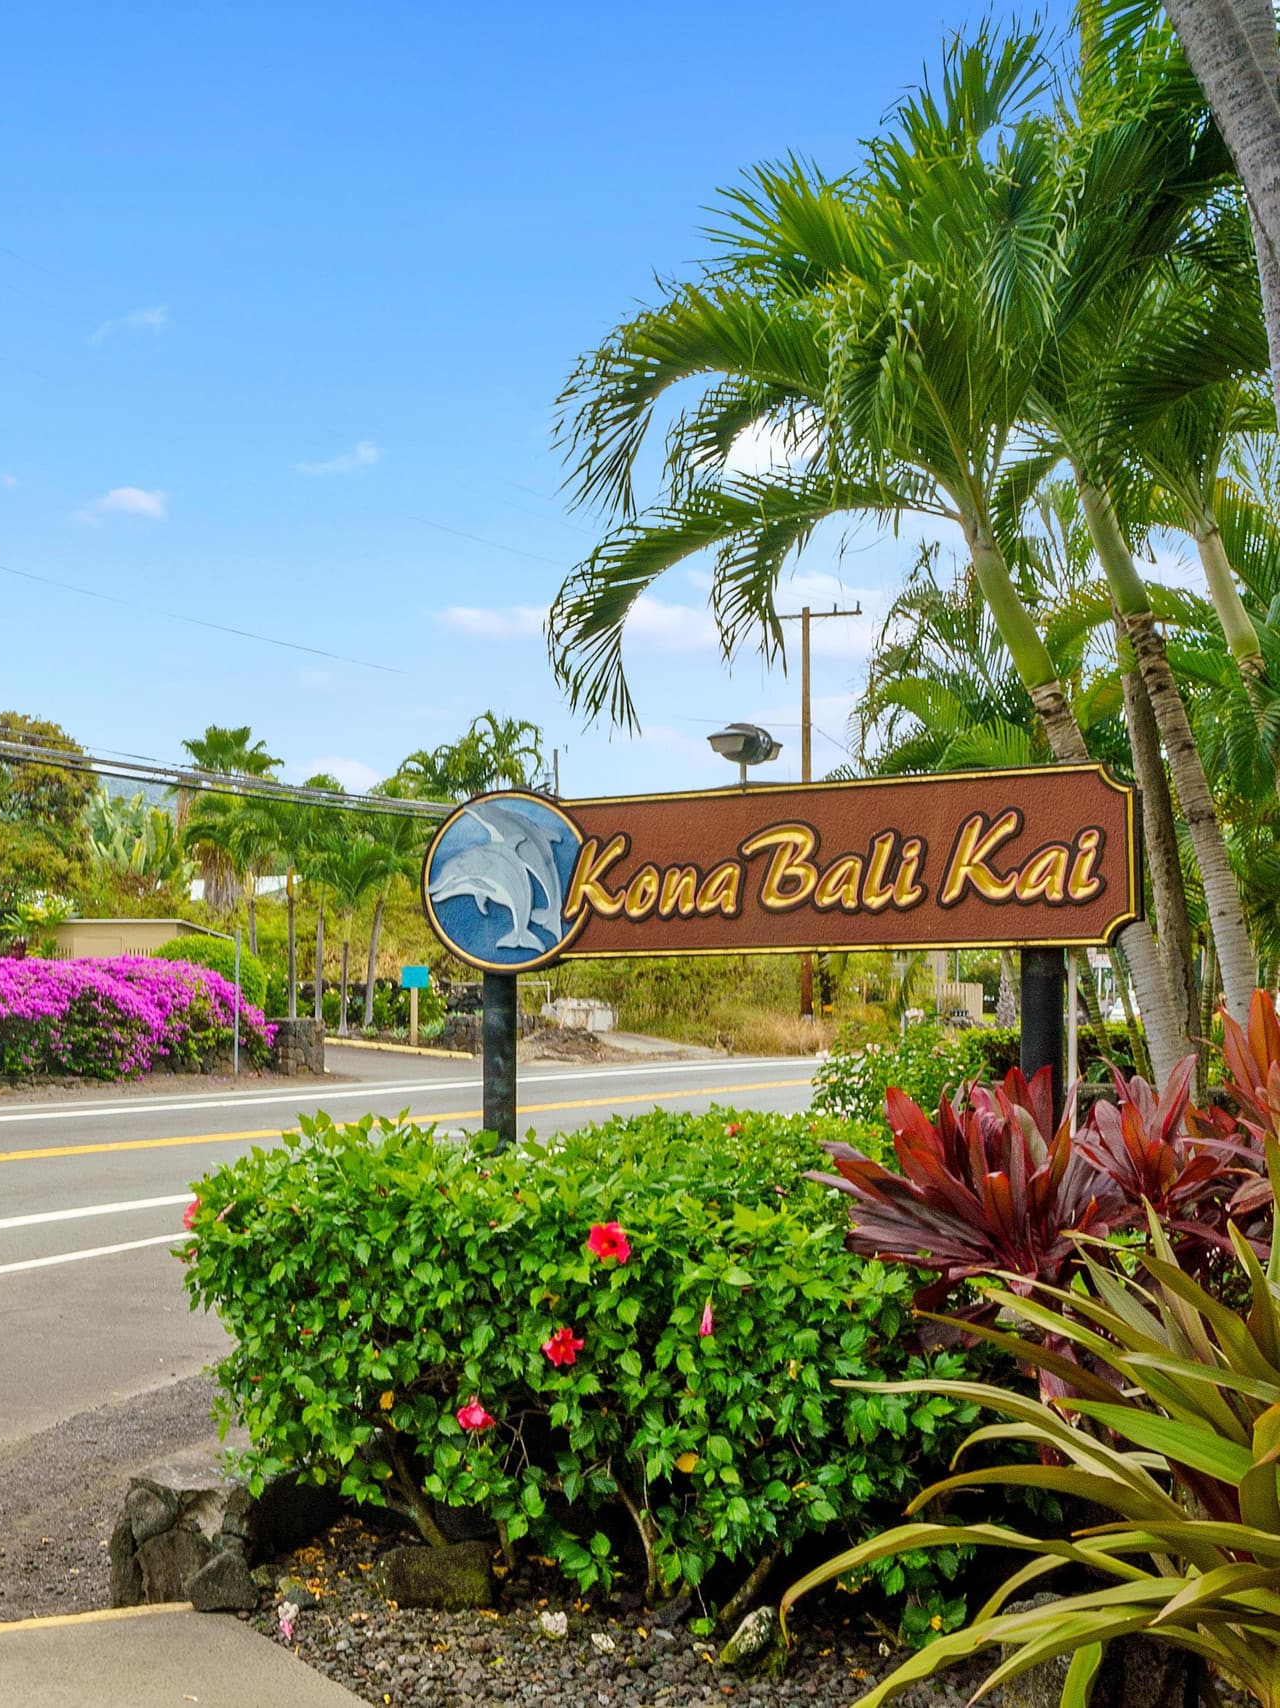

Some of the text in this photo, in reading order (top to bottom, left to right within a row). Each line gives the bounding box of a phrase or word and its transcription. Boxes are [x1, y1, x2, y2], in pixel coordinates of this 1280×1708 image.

[563, 810, 1100, 917] Kona Bali Kai
